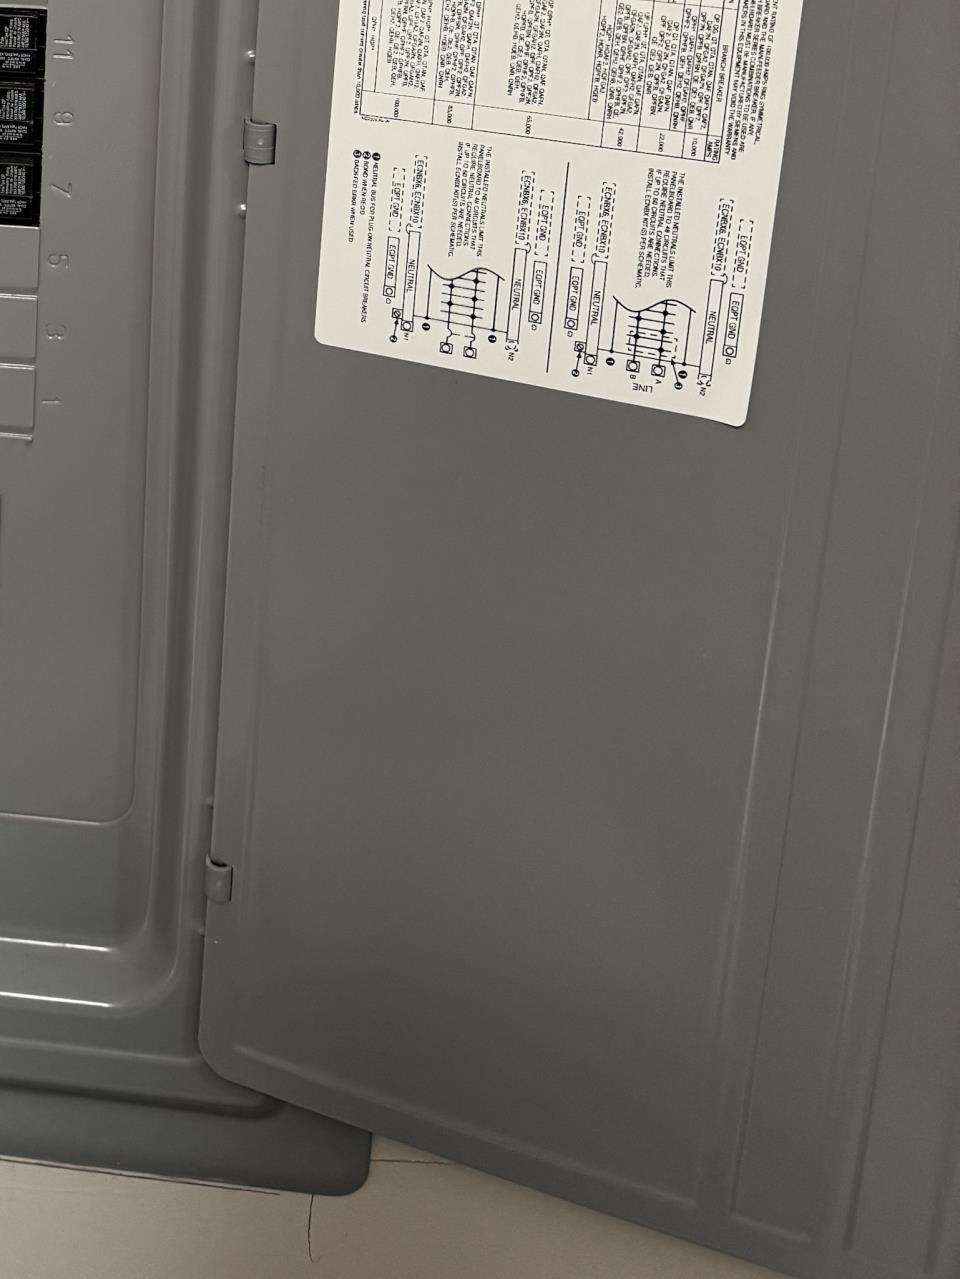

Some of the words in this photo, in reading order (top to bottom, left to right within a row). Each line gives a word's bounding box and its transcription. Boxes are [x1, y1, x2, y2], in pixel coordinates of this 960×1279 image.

[53, 33, 75, 61] 11
[52, 111, 73, 126] 9
[50, 182, 72, 199] 7
[47, 253, 69, 269] 5
[735, 255, 745, 273] GND
[405, 258, 415, 293] NEUTRAL
[589, 289, 601, 326] NEUTRAL
[46, 322, 66, 339] 3
[704, 310, 717, 345] NEUTRAL
[726, 321, 737, 340] GND
[631, 382, 652, 393] LINE
